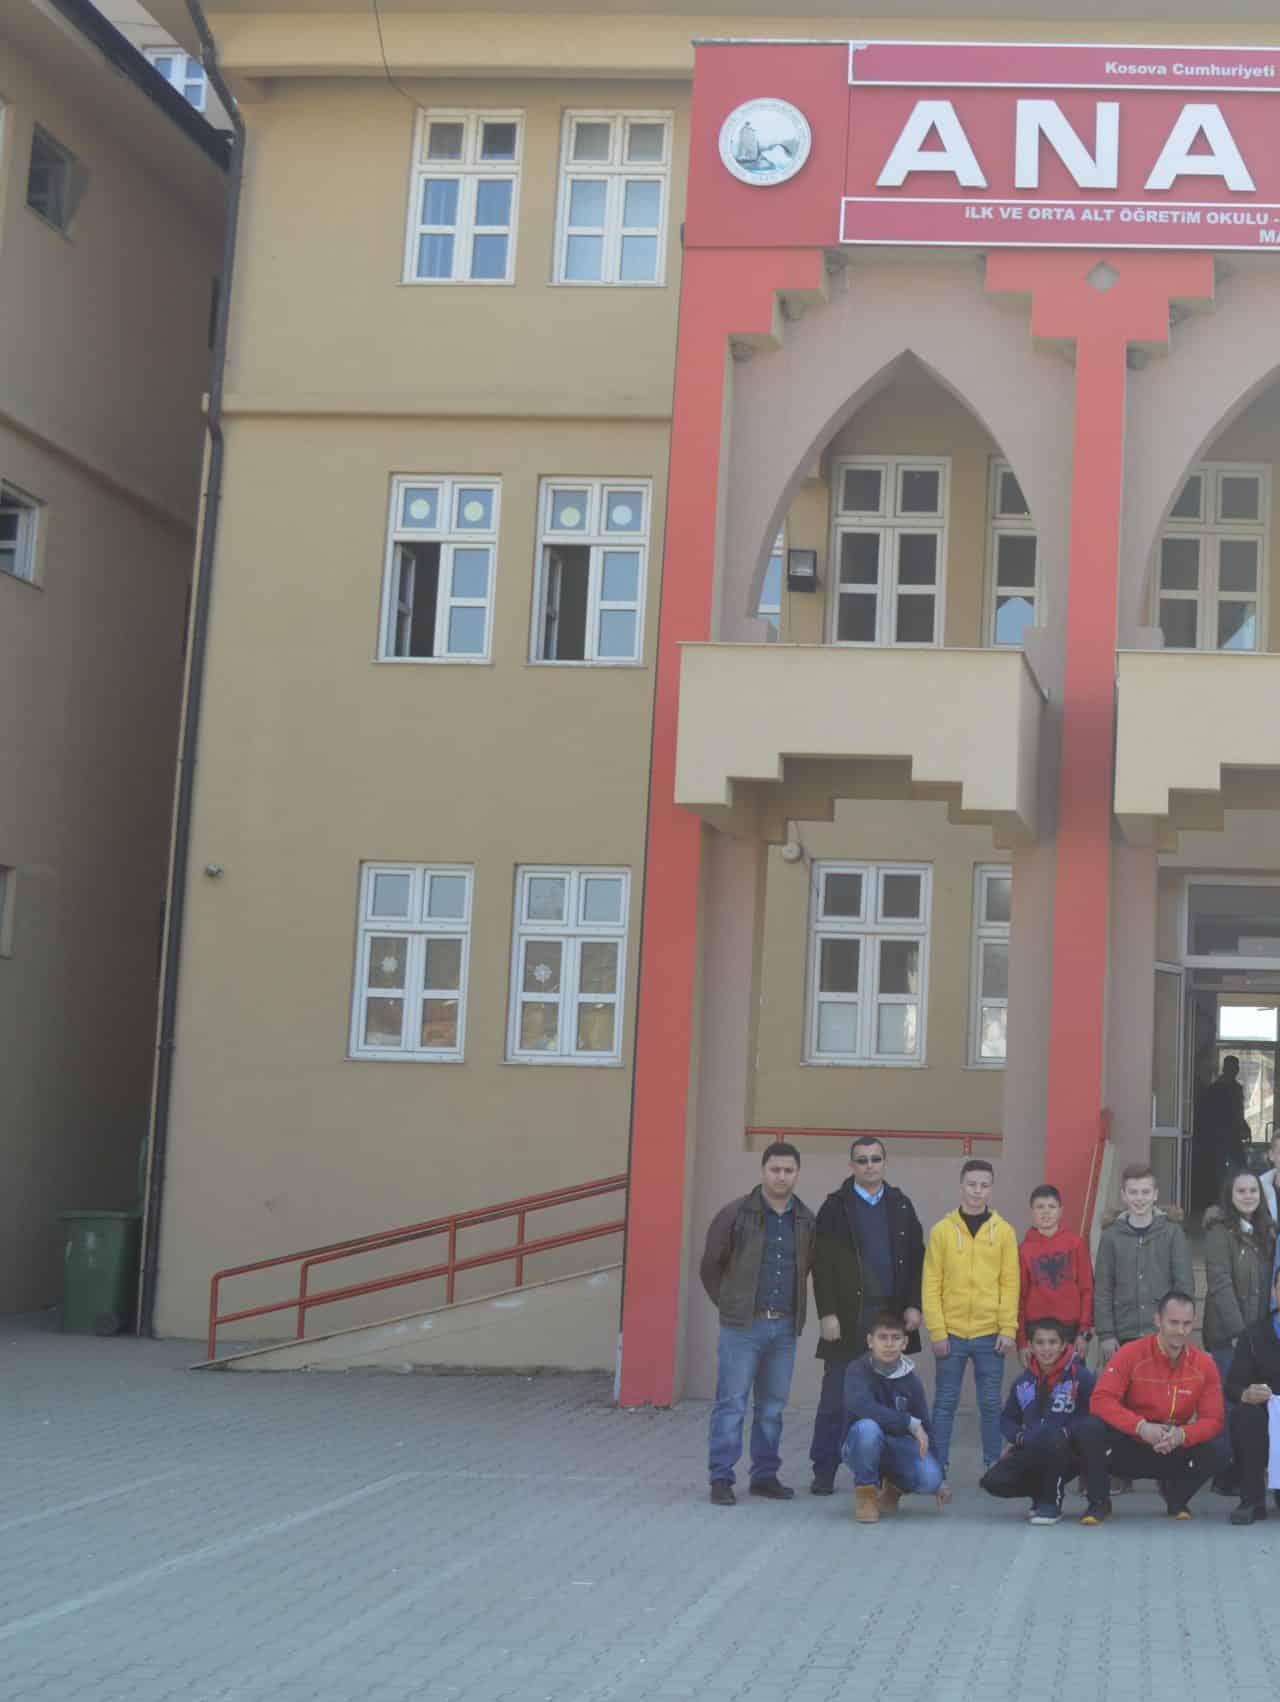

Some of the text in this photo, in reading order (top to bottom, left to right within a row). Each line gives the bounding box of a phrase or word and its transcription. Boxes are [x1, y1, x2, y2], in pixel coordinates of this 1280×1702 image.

[1105, 61, 1275, 81] Kosova Cumhuriyeti
[999, 207, 1023, 219] VE
[1027, 207, 1075, 221] ORTA
[1081, 208, 1115, 222] ALT
[1206, 212, 1269, 225] OKULU
